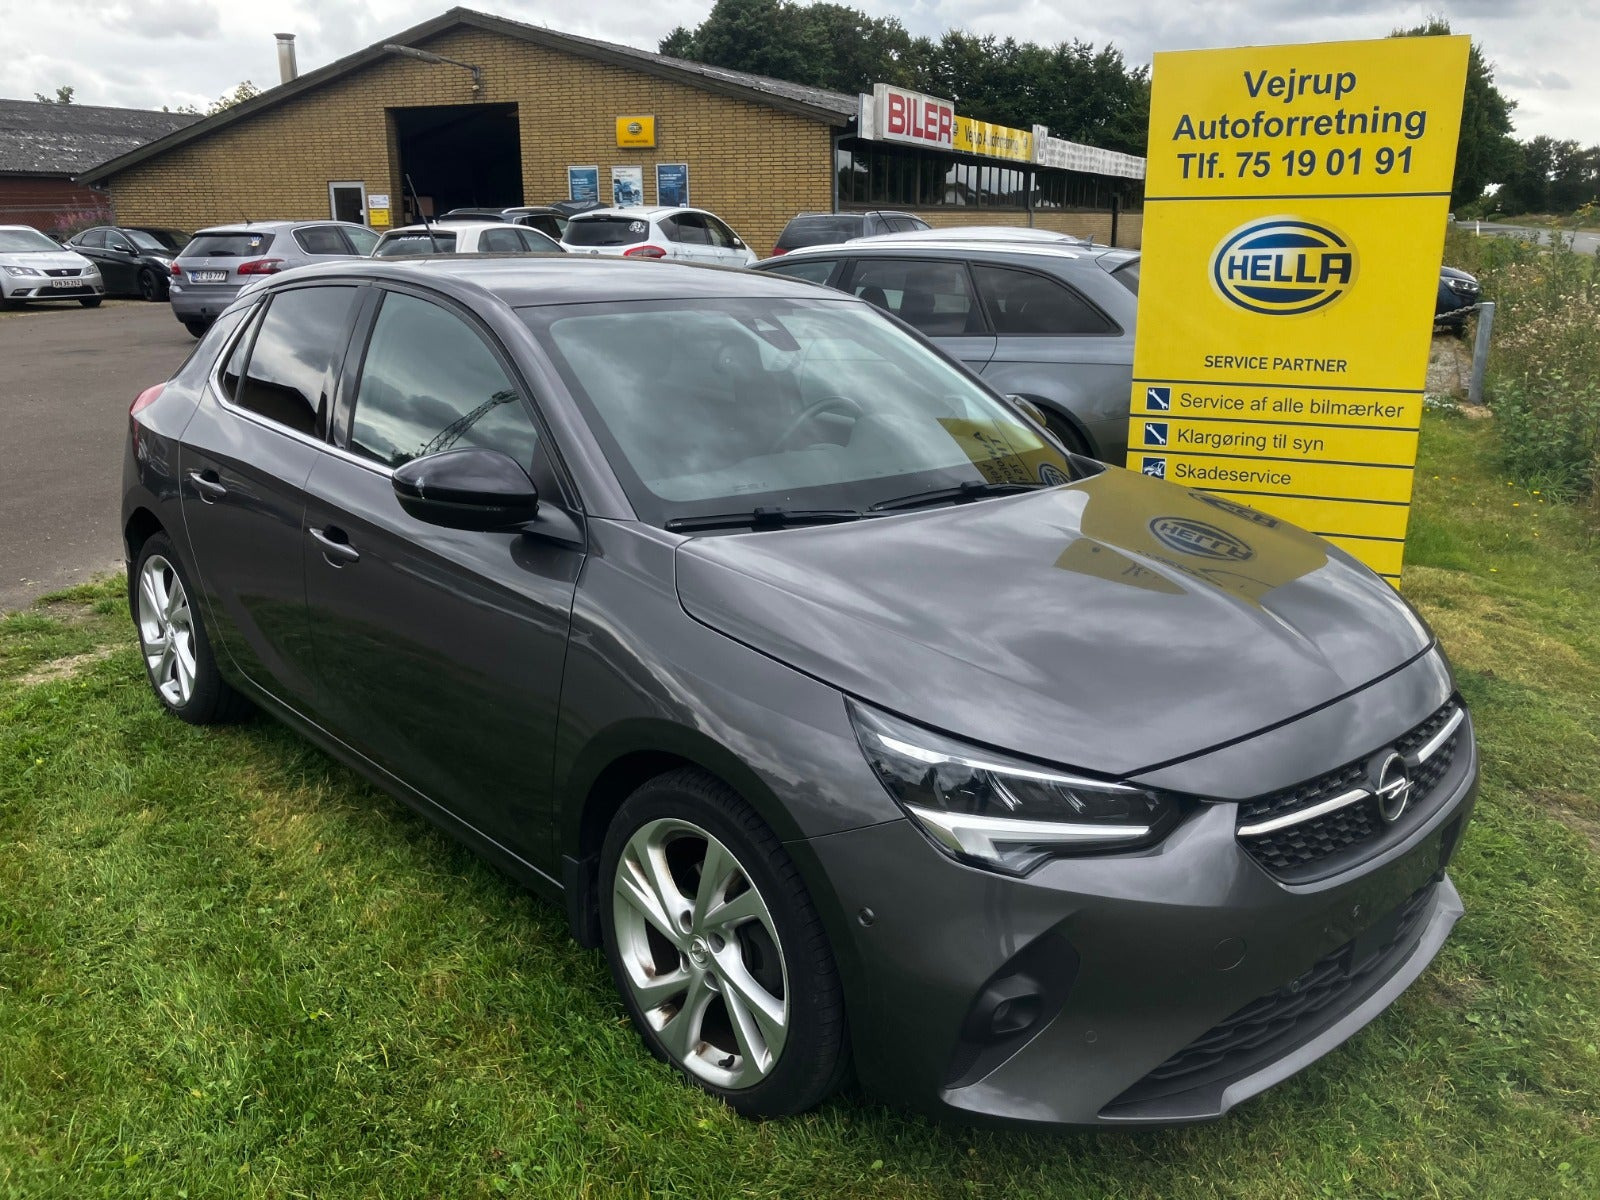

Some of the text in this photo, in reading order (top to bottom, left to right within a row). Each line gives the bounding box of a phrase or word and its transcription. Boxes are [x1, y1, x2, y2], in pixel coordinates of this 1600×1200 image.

[1243, 68, 1357, 104] Vejrup
[888, 93, 952, 144] BILER
[1172, 105, 1427, 141] Autoforretning
[1176, 152, 1225, 179] Tlf.
[1236, 151, 1271, 178] 75
[1282, 149, 1316, 177] 19
[1326, 147, 1362, 176] 01
[1375, 145, 1413, 175] 91
[1227, 252, 1352, 285] HELLA
[1204, 355, 1348, 373] SERVICE PARTNER
[1180, 392, 1405, 418] Service af alle bilmærker
[1176, 428, 1324, 454] Klargøring til syn
[1174, 463, 1292, 485] Skadeservice
